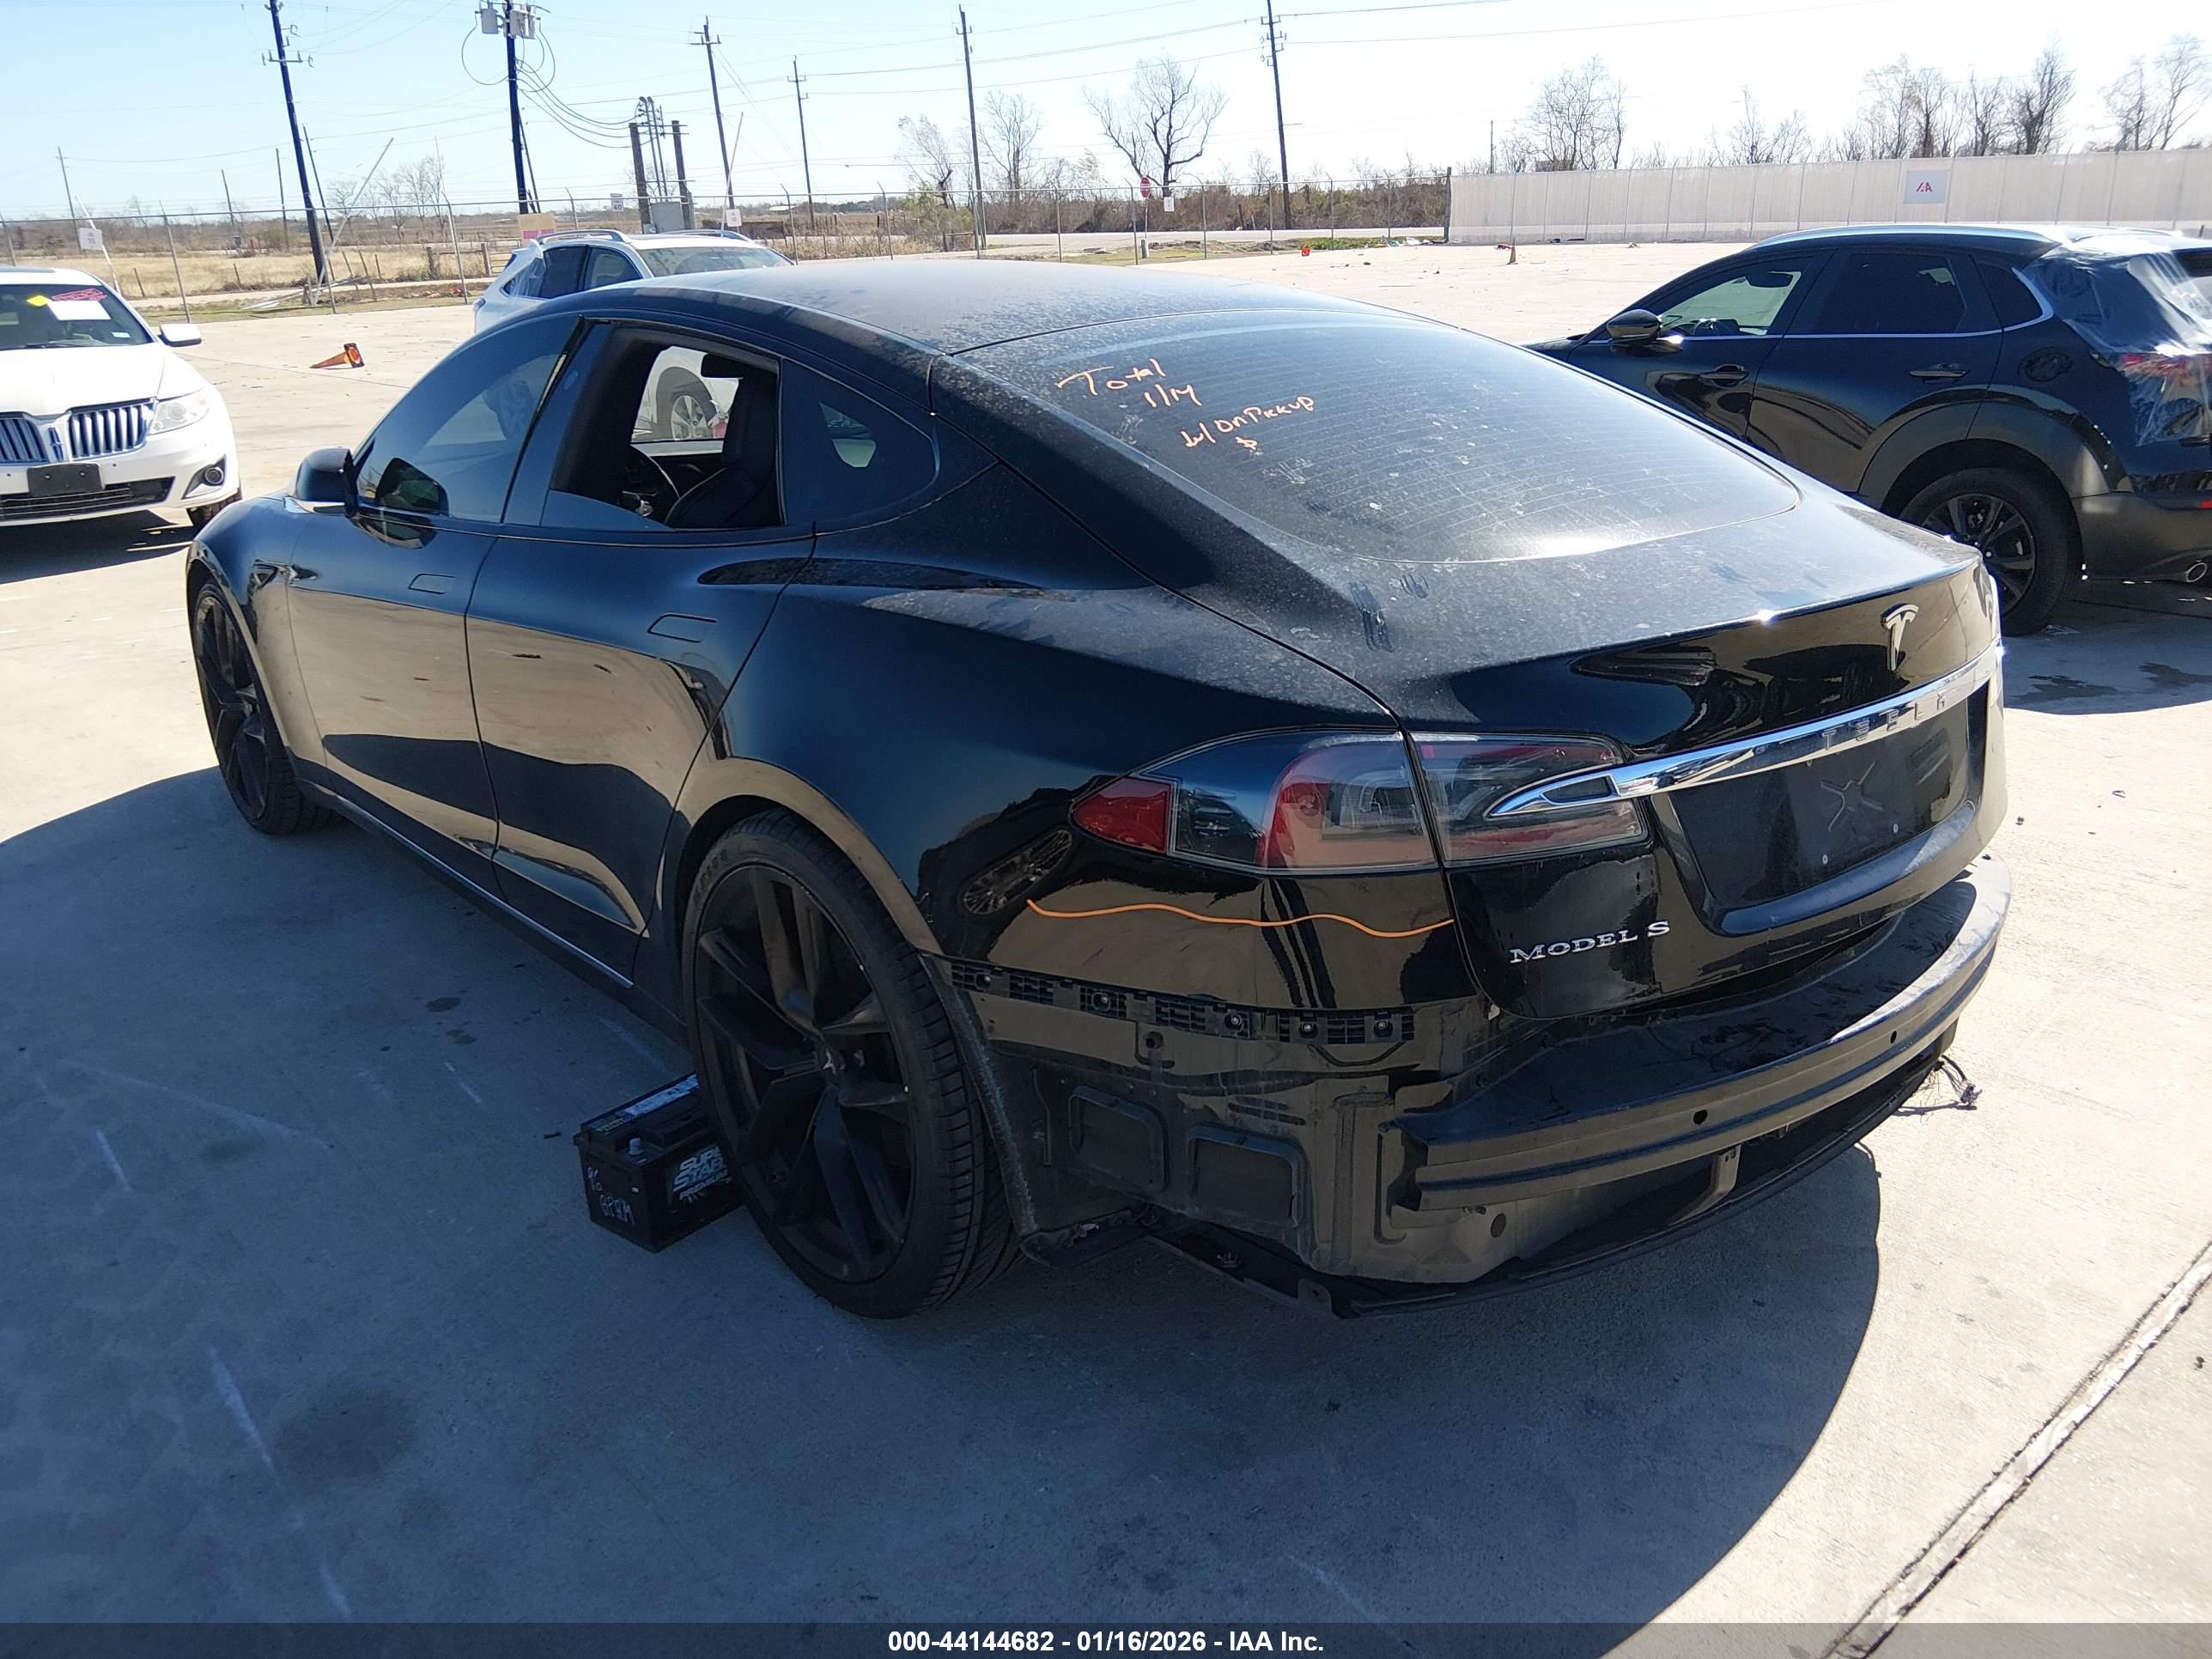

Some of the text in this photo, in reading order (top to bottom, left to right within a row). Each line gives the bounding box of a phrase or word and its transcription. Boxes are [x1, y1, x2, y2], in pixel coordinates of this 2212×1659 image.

[1054, 358, 1166, 396] Total
[1821, 689, 1953, 750] TESLA
[1510, 921, 1670, 963] MODEL S
